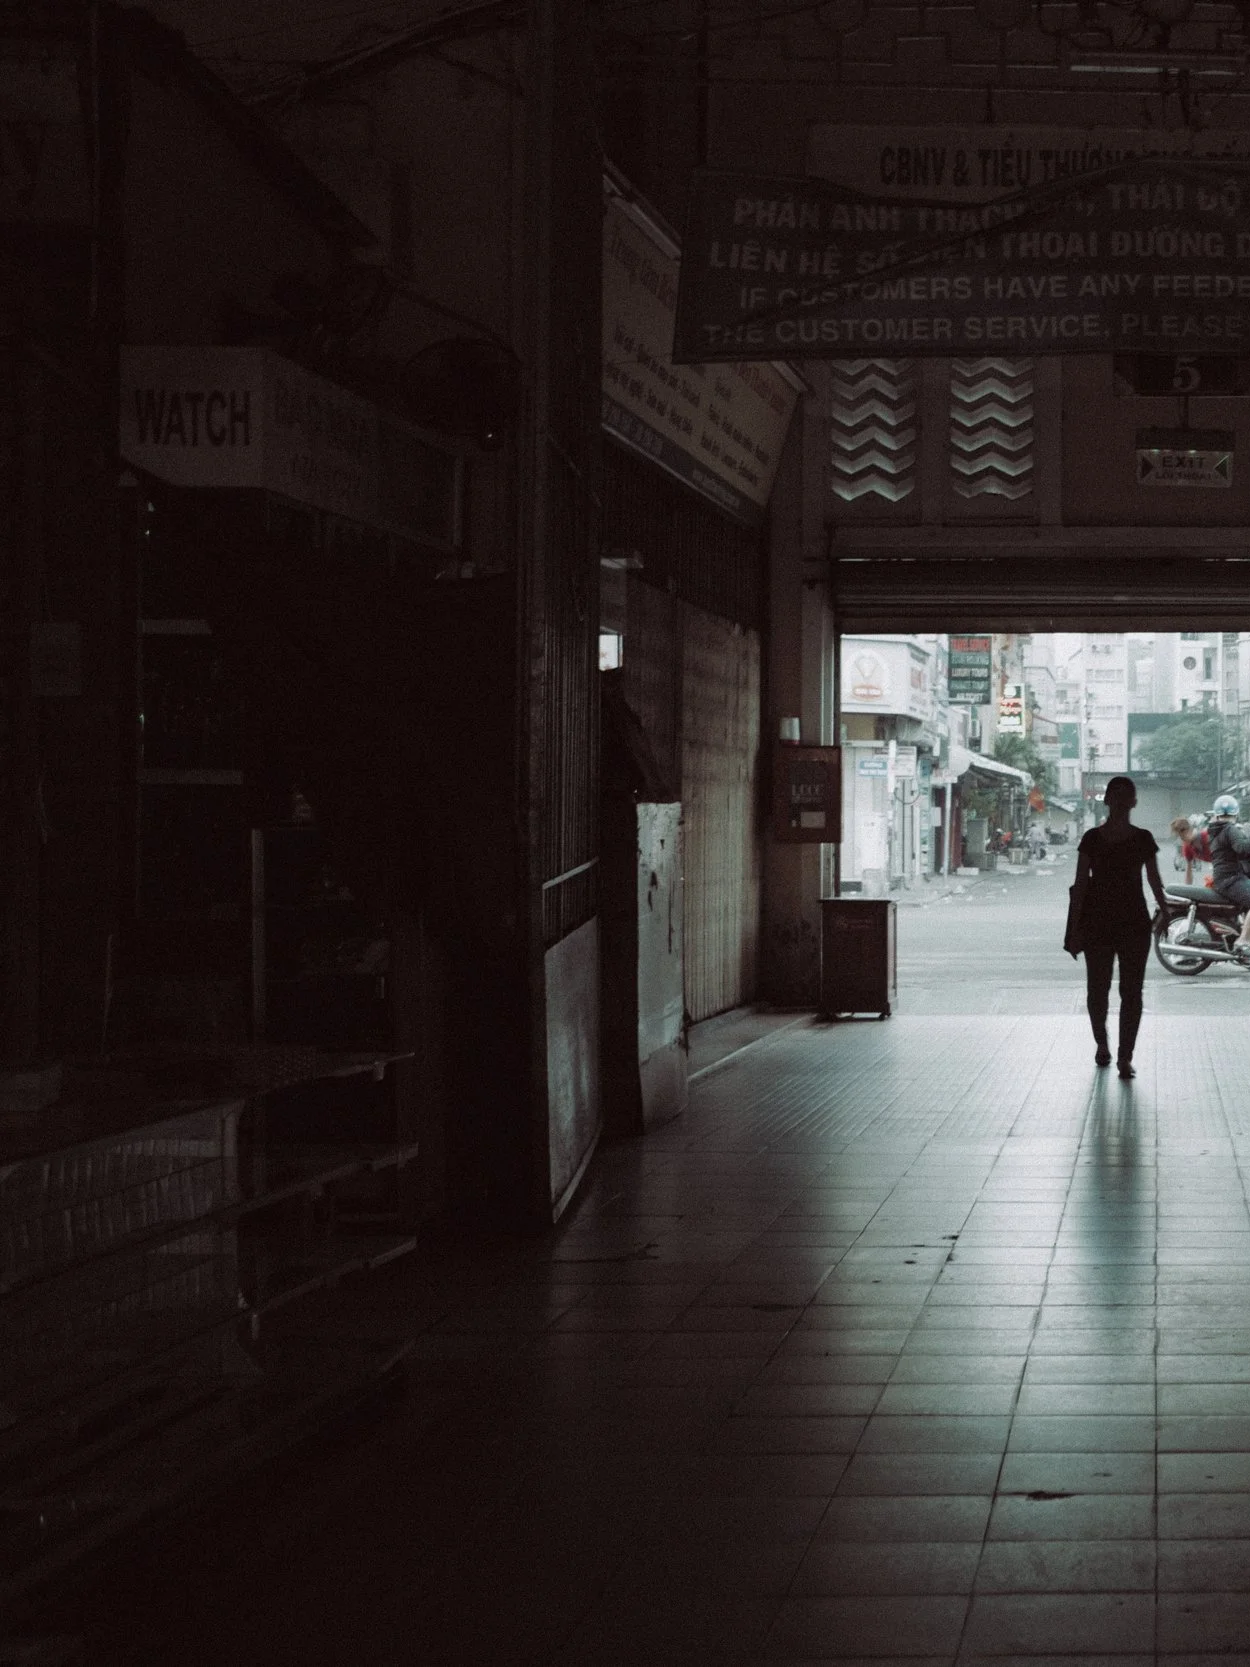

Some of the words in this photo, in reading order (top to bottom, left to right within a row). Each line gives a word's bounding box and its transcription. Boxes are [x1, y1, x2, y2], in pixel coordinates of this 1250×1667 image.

[953, 148, 969, 188] &
[740, 286, 768, 309] IF
[983, 275, 1066, 299] HAVE
[1076, 274, 1140, 298] ANY
[775, 317, 953, 343] CUSTOMER
[1121, 312, 1244, 339] PLEASE
[1173, 356, 1202, 393] 5
[134, 388, 252, 447] WATCH
[1162, 455, 1206, 468] EXIT
